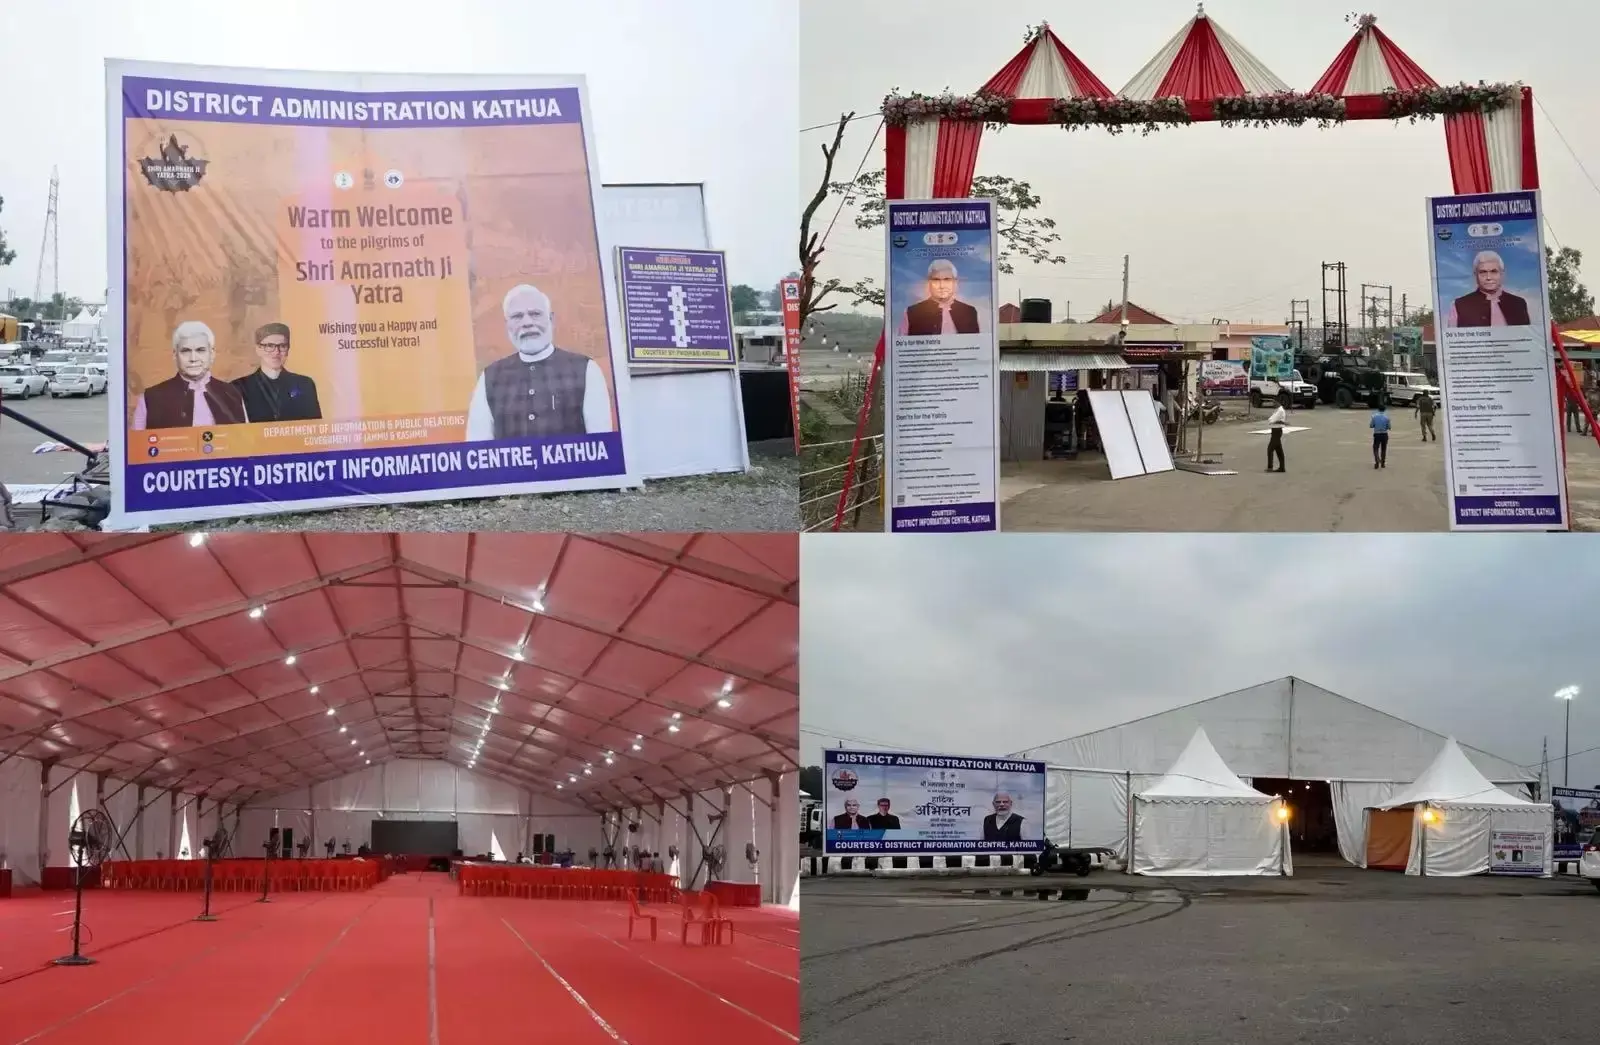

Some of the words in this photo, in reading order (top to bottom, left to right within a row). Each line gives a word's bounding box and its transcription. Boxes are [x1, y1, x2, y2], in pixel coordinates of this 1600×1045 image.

[146, 88, 263, 117] DISTRICT
[270, 97, 466, 121] ADMINISTRATION
[472, 98, 562, 120] KATHUA
[288, 206, 350, 228] Warm
[356, 204, 453, 228] Welcome
[894, 212, 918, 225] DISTRICT
[919, 210, 964, 224] ADMINISTRATION
[965, 210, 986, 224] KATHUA
[1436, 204, 1461, 218] DISTRICT
[1462, 201, 1508, 217] ADMINISTRATION
[1510, 200, 1532, 214] KATHUA
[320, 237, 334, 249] to
[337, 236, 357, 249] the
[360, 234, 410, 251] pilgrims
[412, 234, 425, 247] of
[296, 260, 335, 282] Shri
[340, 257, 435, 280] Amarnath
[440, 256, 452, 280] Ji
[351, 284, 403, 304] Yatra
[319, 322, 357, 335] Wishing
[359, 323, 377, 334] you
[379, 323, 385, 331] a
[387, 320, 418, 332] Happy
[419, 318, 438, 330] and
[338, 336, 389, 350] Successful
[391, 335, 420, 348] Yatra!
[264, 425, 316, 438] DEPARTMENT
[319, 424, 328, 434] OF
[331, 420, 385, 434] INFORMATION
[395, 418, 422, 429] PUBLIC
[423, 416, 465, 428] RELATIONS
[304, 434, 351, 446] GOVERNMENT
[354, 433, 362, 443] OF
[364, 432, 388, 443] JAMMU
[397, 430, 427, 440] KASHMIR
[143, 466, 249, 493] COURTESY:
[254, 460, 336, 486] DISTRICT
[343, 451, 462, 479] INFORMATION
[466, 447, 538, 470] CENTRE,
[542, 440, 608, 464] KATHUA
[1461, 508, 1482, 516] DISTRICT
[1483, 508, 1514, 516] INFORMATION
[896, 519, 917, 528] DISTRICT
[919, 517, 950, 526] INFORMATION
[972, 514, 990, 523] KATHUA
[836, 754, 893, 765] DISTRICT
[897, 756, 992, 769] ADMINISTRATION
[994, 761, 1036, 772] KATHUA
[915, 802, 971, 816] अभिनंदन
[835, 841, 883, 849] COURTESY:
[977, 841, 1008, 849] CENTRE,
